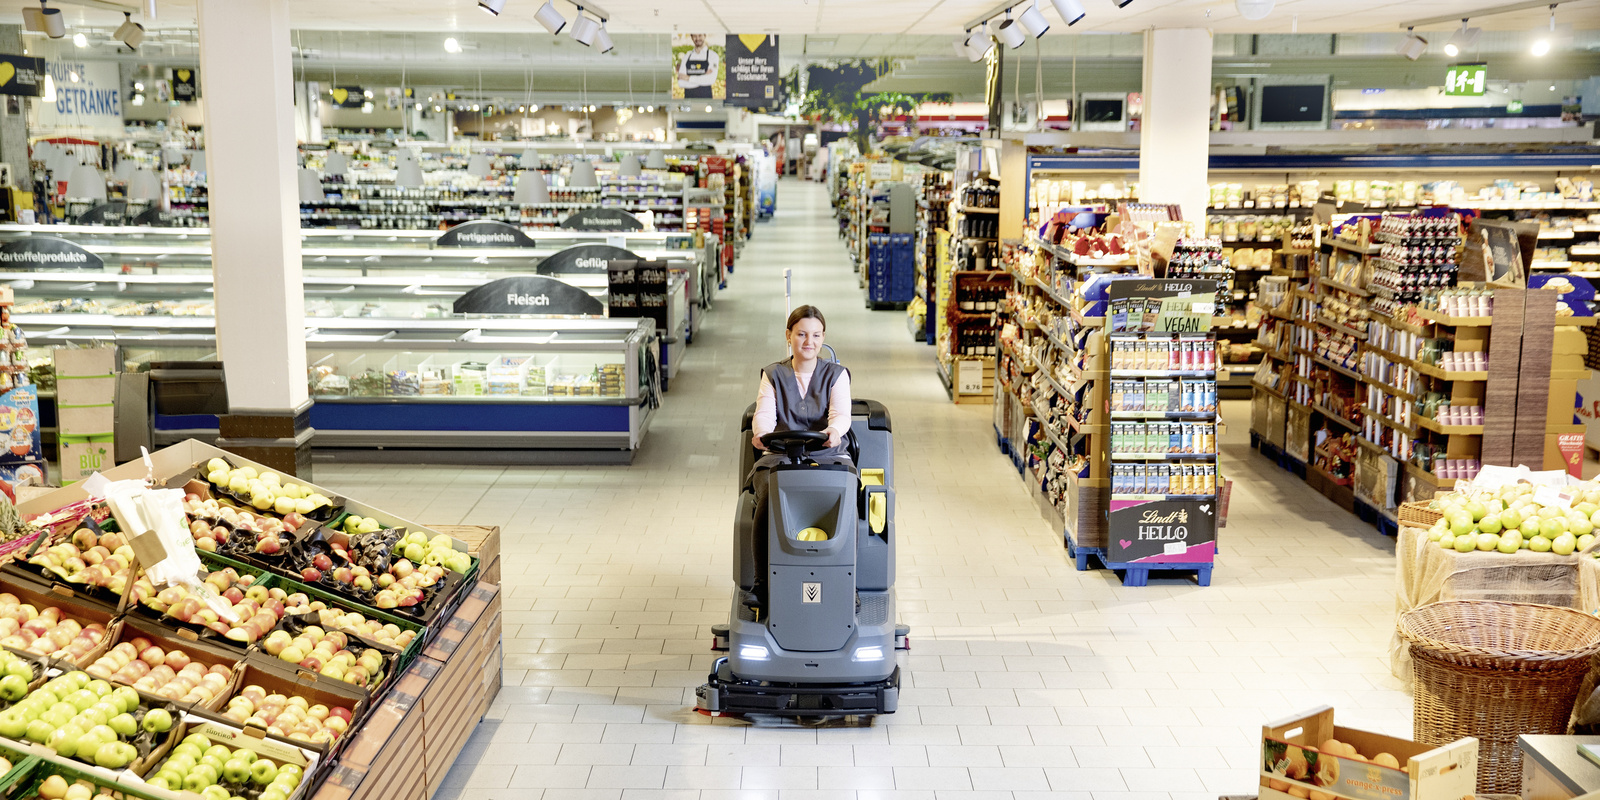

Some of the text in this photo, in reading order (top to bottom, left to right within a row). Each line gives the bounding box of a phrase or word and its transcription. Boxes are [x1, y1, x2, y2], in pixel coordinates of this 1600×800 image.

[57, 81, 119, 116] GETRÄNKE
[583, 217, 622, 227] Backwaren
[457, 232, 515, 244] Fertiggerichte
[575, 257, 609, 270] Geflüg
[1135, 283, 1192, 292] Lindt HELLO
[507, 293, 550, 306] Fleisch
[1166, 302, 1193, 311] HELL
[1165, 317, 1200, 332] VEGAN
[80, 454, 101, 469] BIO
[1138, 509, 1179, 524] Lindt
[1137, 526, 1188, 541] HELLO
